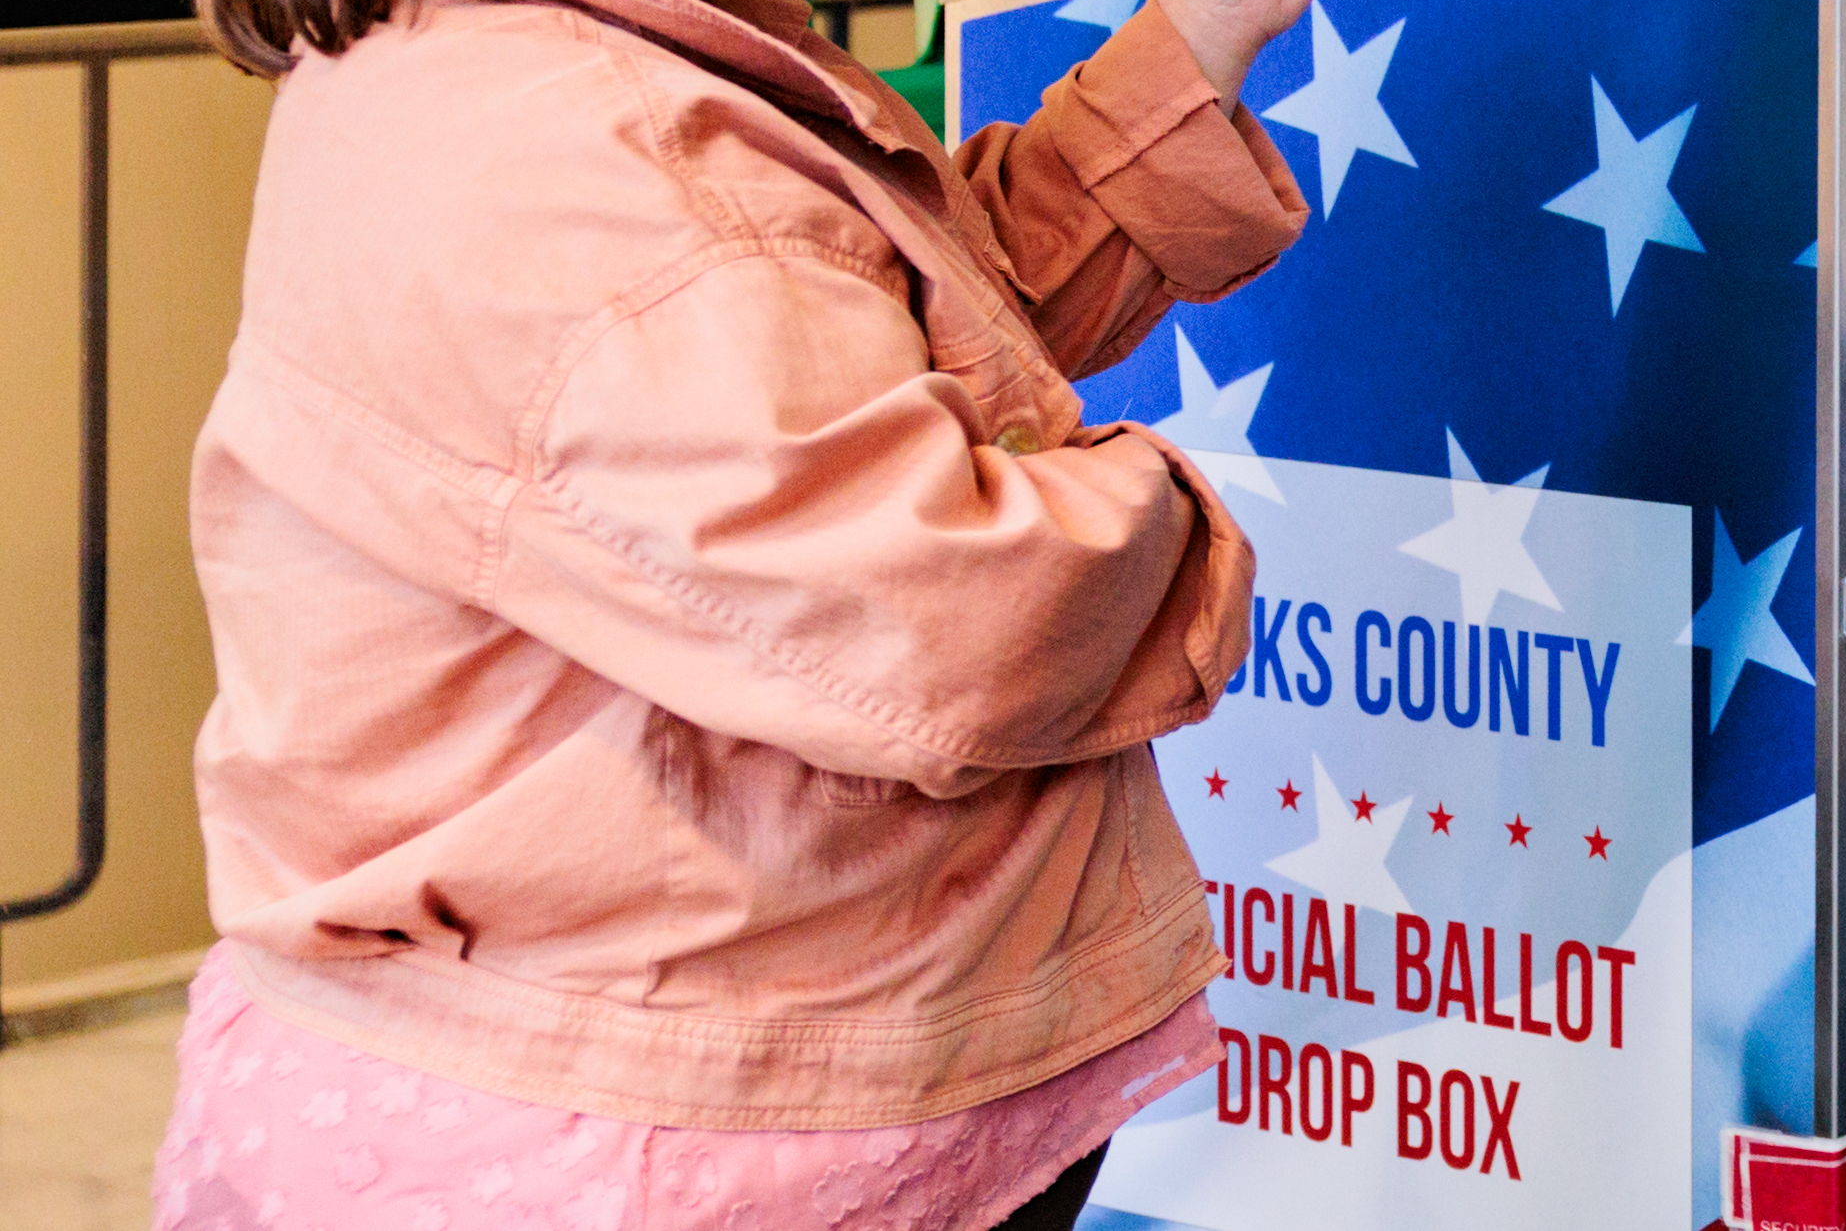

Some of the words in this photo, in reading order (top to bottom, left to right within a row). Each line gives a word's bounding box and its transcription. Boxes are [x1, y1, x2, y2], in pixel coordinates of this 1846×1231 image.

[1354, 608, 1621, 749] COUNTY
[1203, 879, 1376, 1006] ICIAL
[1395, 910, 1636, 1050] BALLOT
[1216, 1026, 1375, 1148] DROP
[1395, 1059, 1522, 1182] BOX
